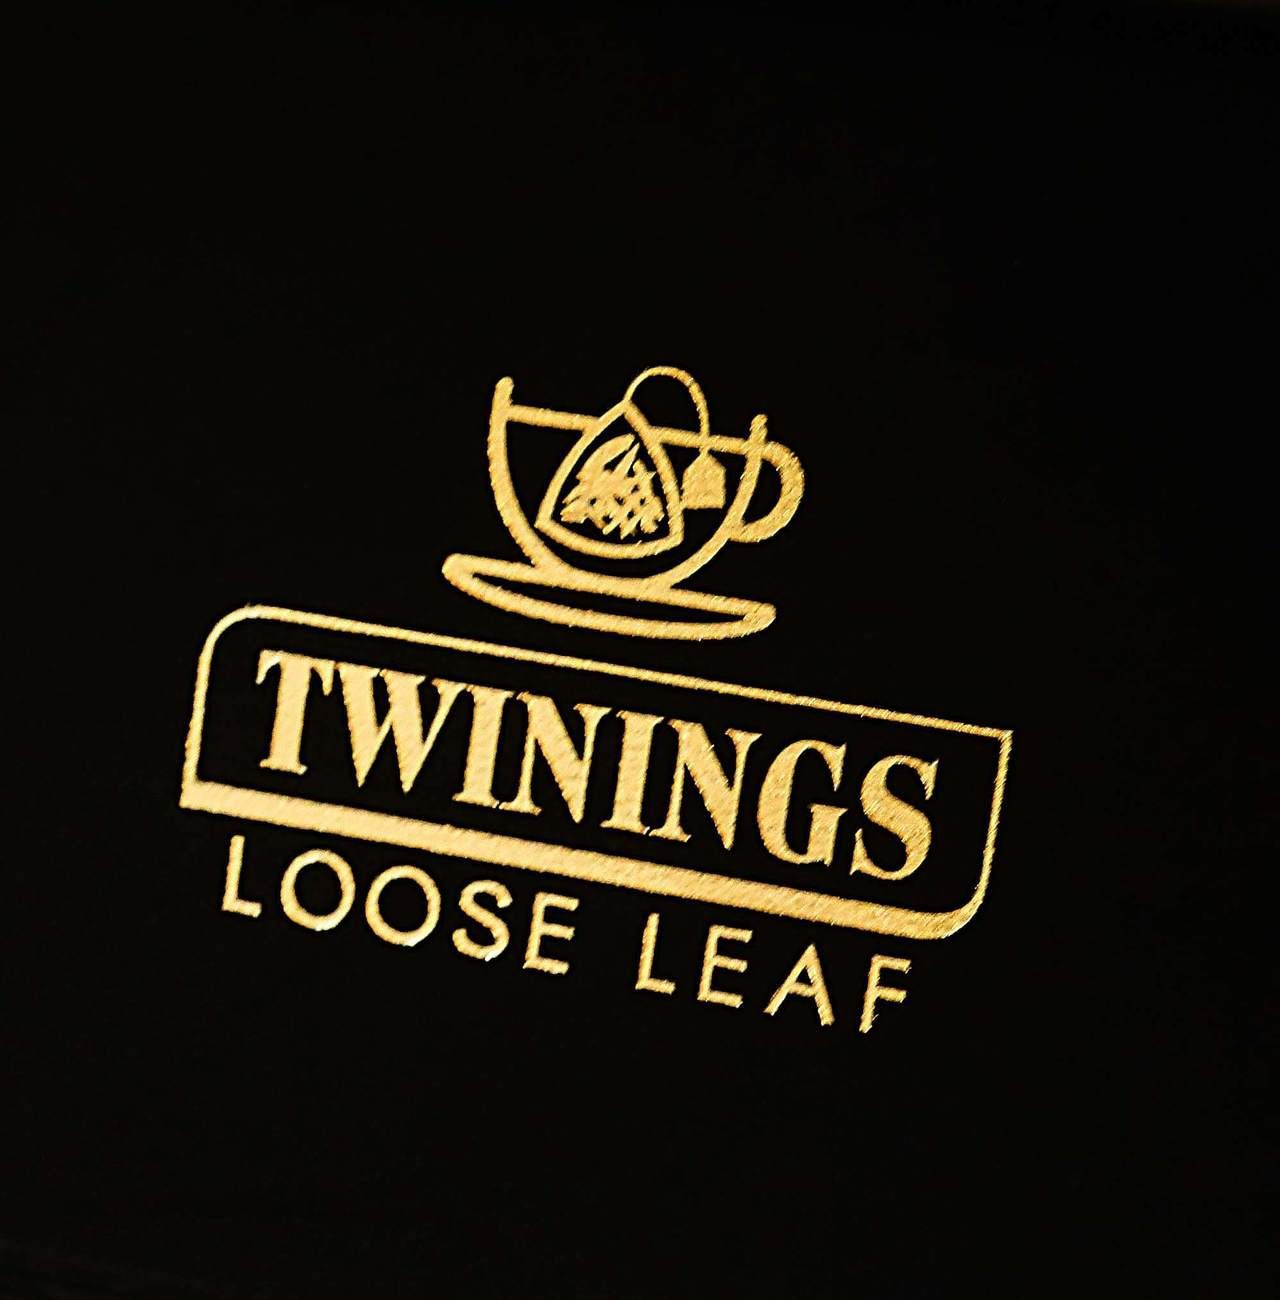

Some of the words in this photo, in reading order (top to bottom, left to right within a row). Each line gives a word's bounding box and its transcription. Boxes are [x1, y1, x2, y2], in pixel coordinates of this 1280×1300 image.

[255, 649, 939, 881] TWININGS
[221, 834, 580, 975] LOOSE
[634, 912, 912, 1034] LEAF
